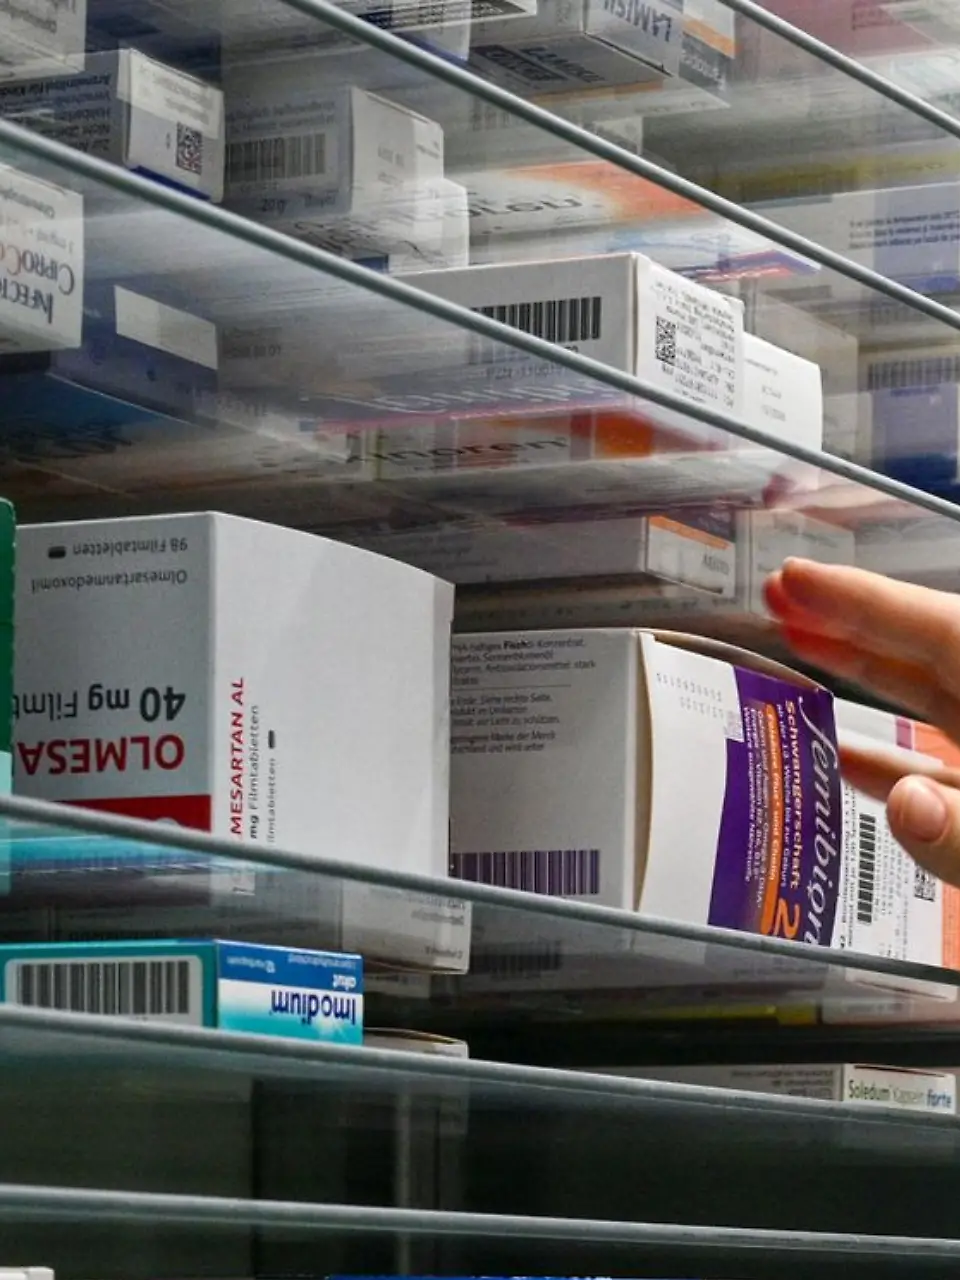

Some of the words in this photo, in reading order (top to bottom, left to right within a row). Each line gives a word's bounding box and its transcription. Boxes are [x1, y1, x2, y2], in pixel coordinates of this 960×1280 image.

[72, 538, 166, 558] Filmtabletten
[170, 537, 188, 552] 98
[30, 568, 188, 594] Olmesartanmedoxomil
[87, 683, 130, 713] mg
[139, 686, 186, 723] 40
[231, 677, 244, 706] AL
[16, 733, 185, 776] OLMESA
[785, 699, 804, 890] Schwangerschaft
[775, 897, 800, 938] 2
[272, 990, 357, 1026] Imodium
